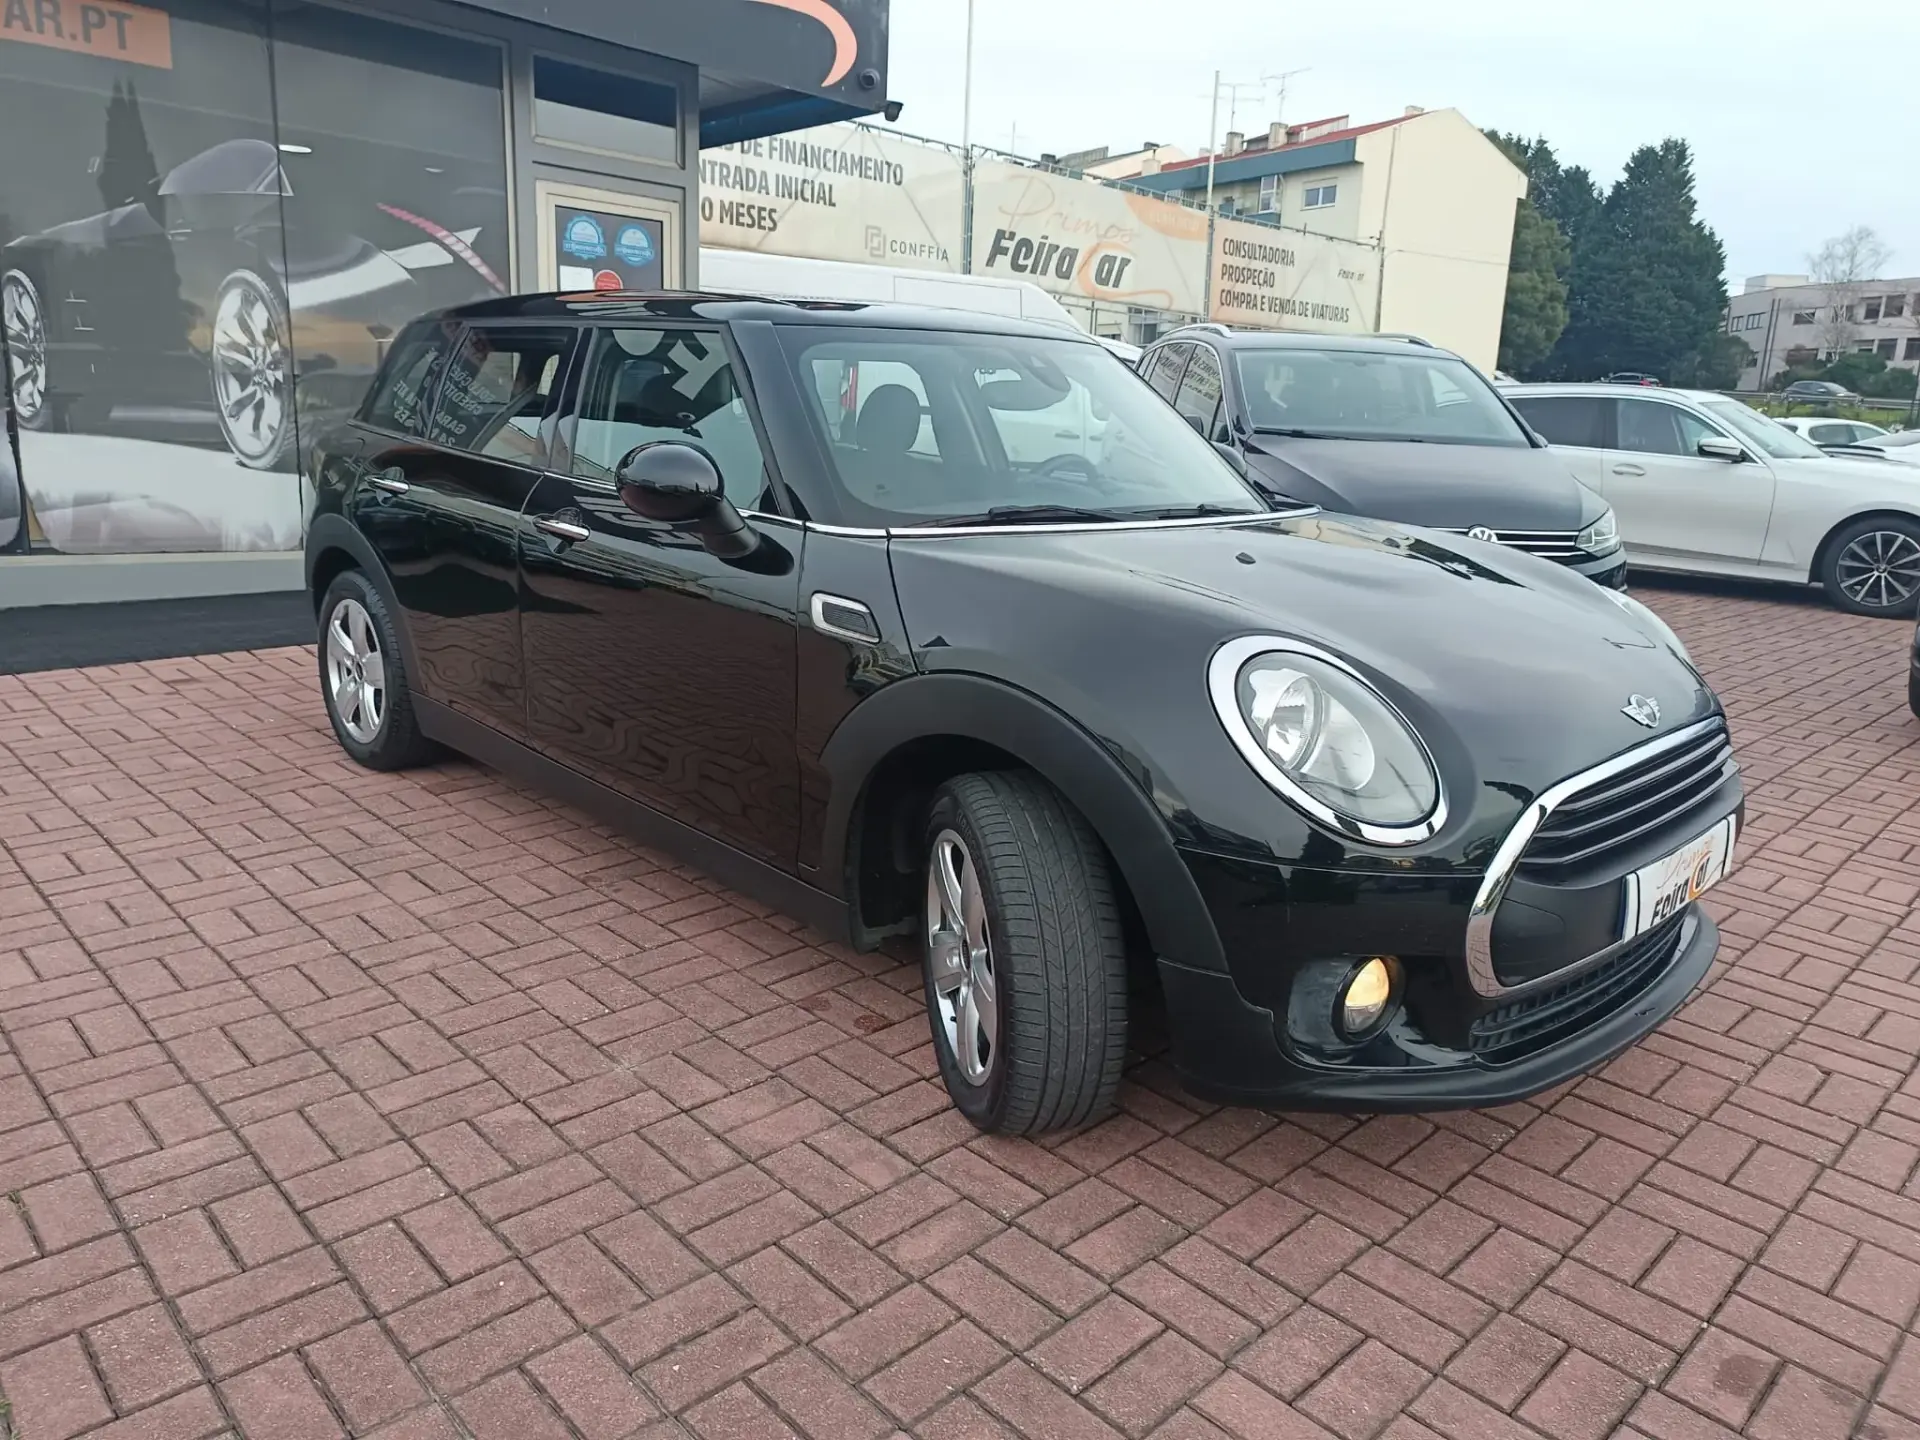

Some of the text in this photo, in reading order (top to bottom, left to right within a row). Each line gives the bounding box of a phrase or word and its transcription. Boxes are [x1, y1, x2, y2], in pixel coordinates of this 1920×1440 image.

[3, 0, 134, 51] AR.PT
[768, 137, 904, 187] FINANCIAMENTO
[775, 173, 837, 207] INICIAL
[719, 199, 778, 232] MESES
[998, 174, 1141, 243] Primos
[890, 239, 949, 262] CONFFIA
[1222, 237, 1296, 267] CONSULTADORIA
[1220, 263, 1276, 290] PROSPEÇÃO
[1219, 289, 1350, 323] COMPRA E VENDA DE VIATURAS
